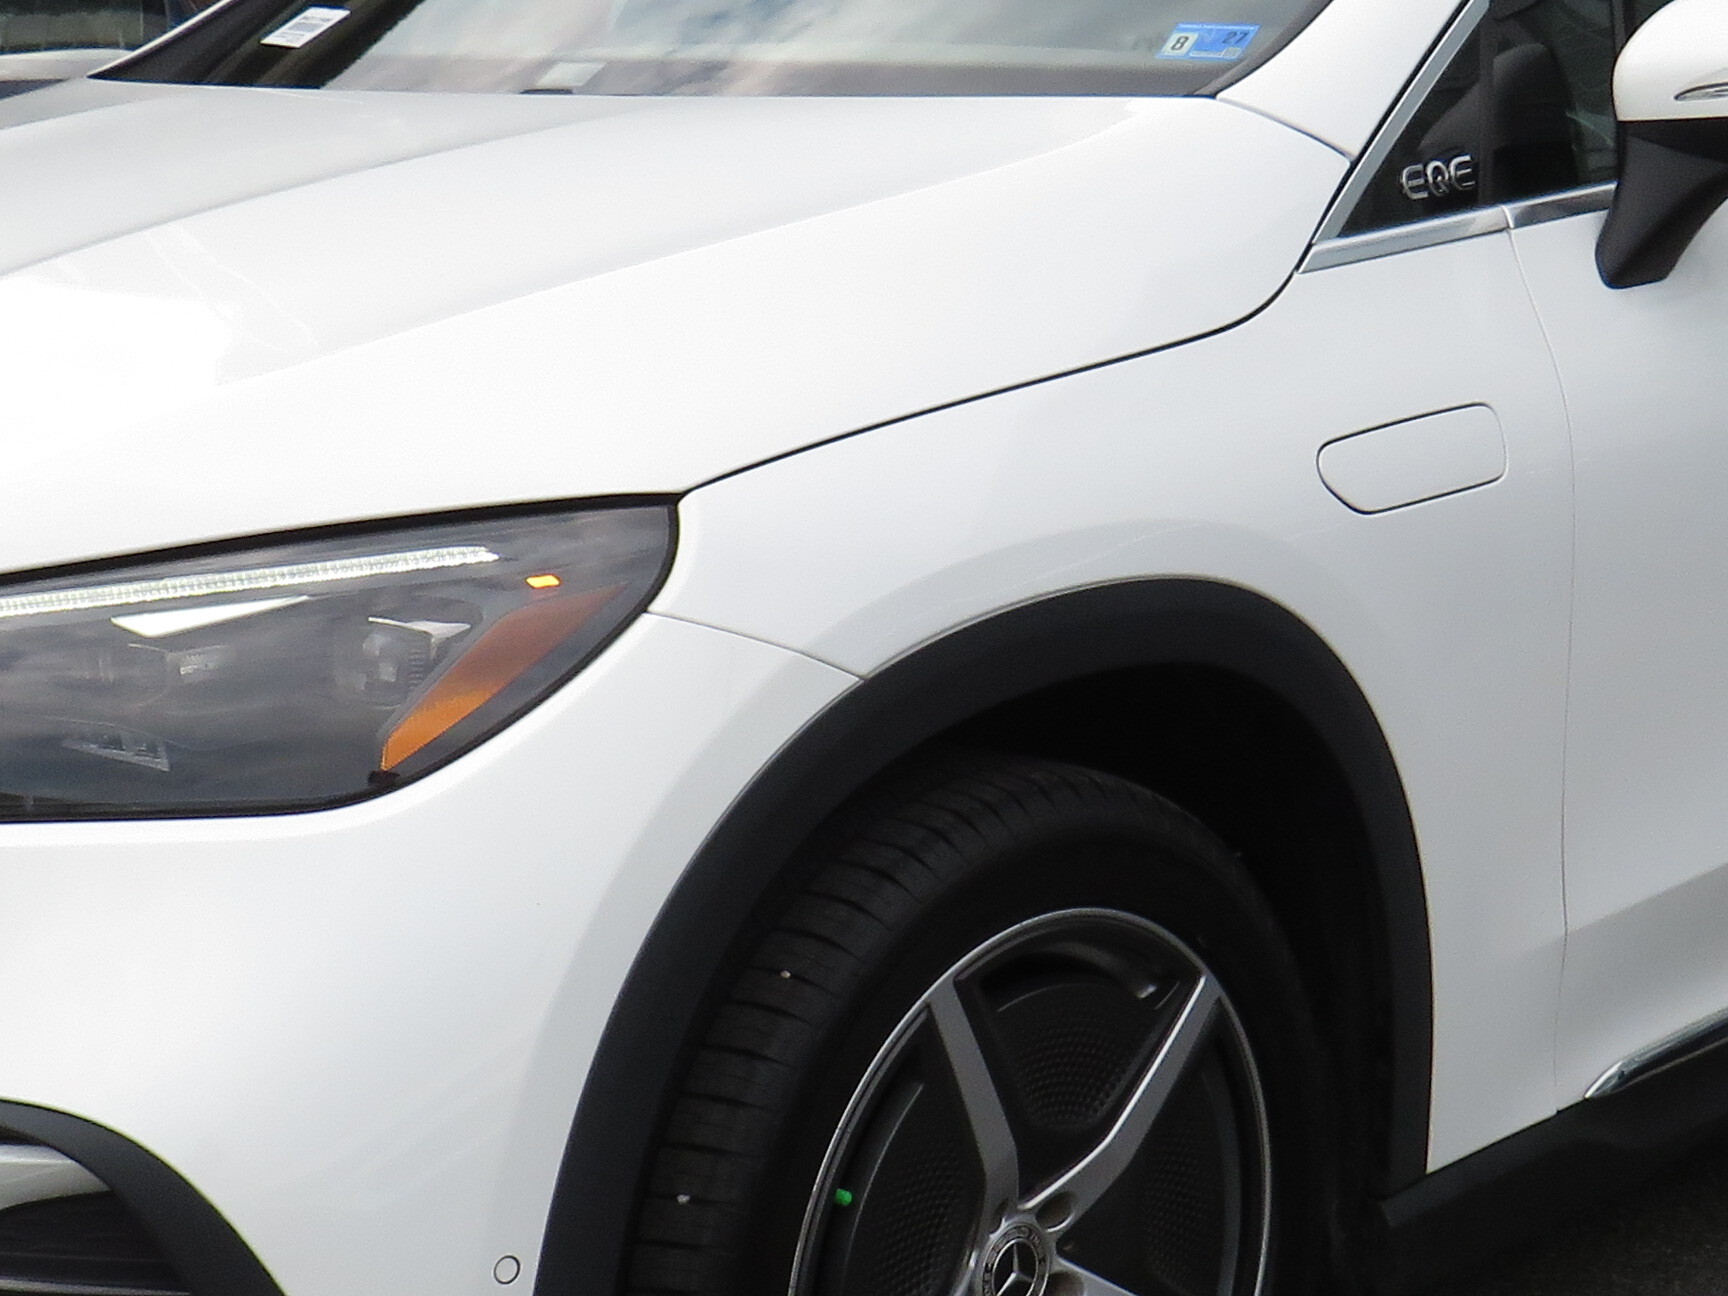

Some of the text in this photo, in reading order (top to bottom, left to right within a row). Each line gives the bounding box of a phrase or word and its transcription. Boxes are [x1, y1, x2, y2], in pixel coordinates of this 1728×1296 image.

[1170, 35, 1190, 51] 8
[1221, 30, 1251, 45] 27
[1401, 153, 1476, 201] EQE
